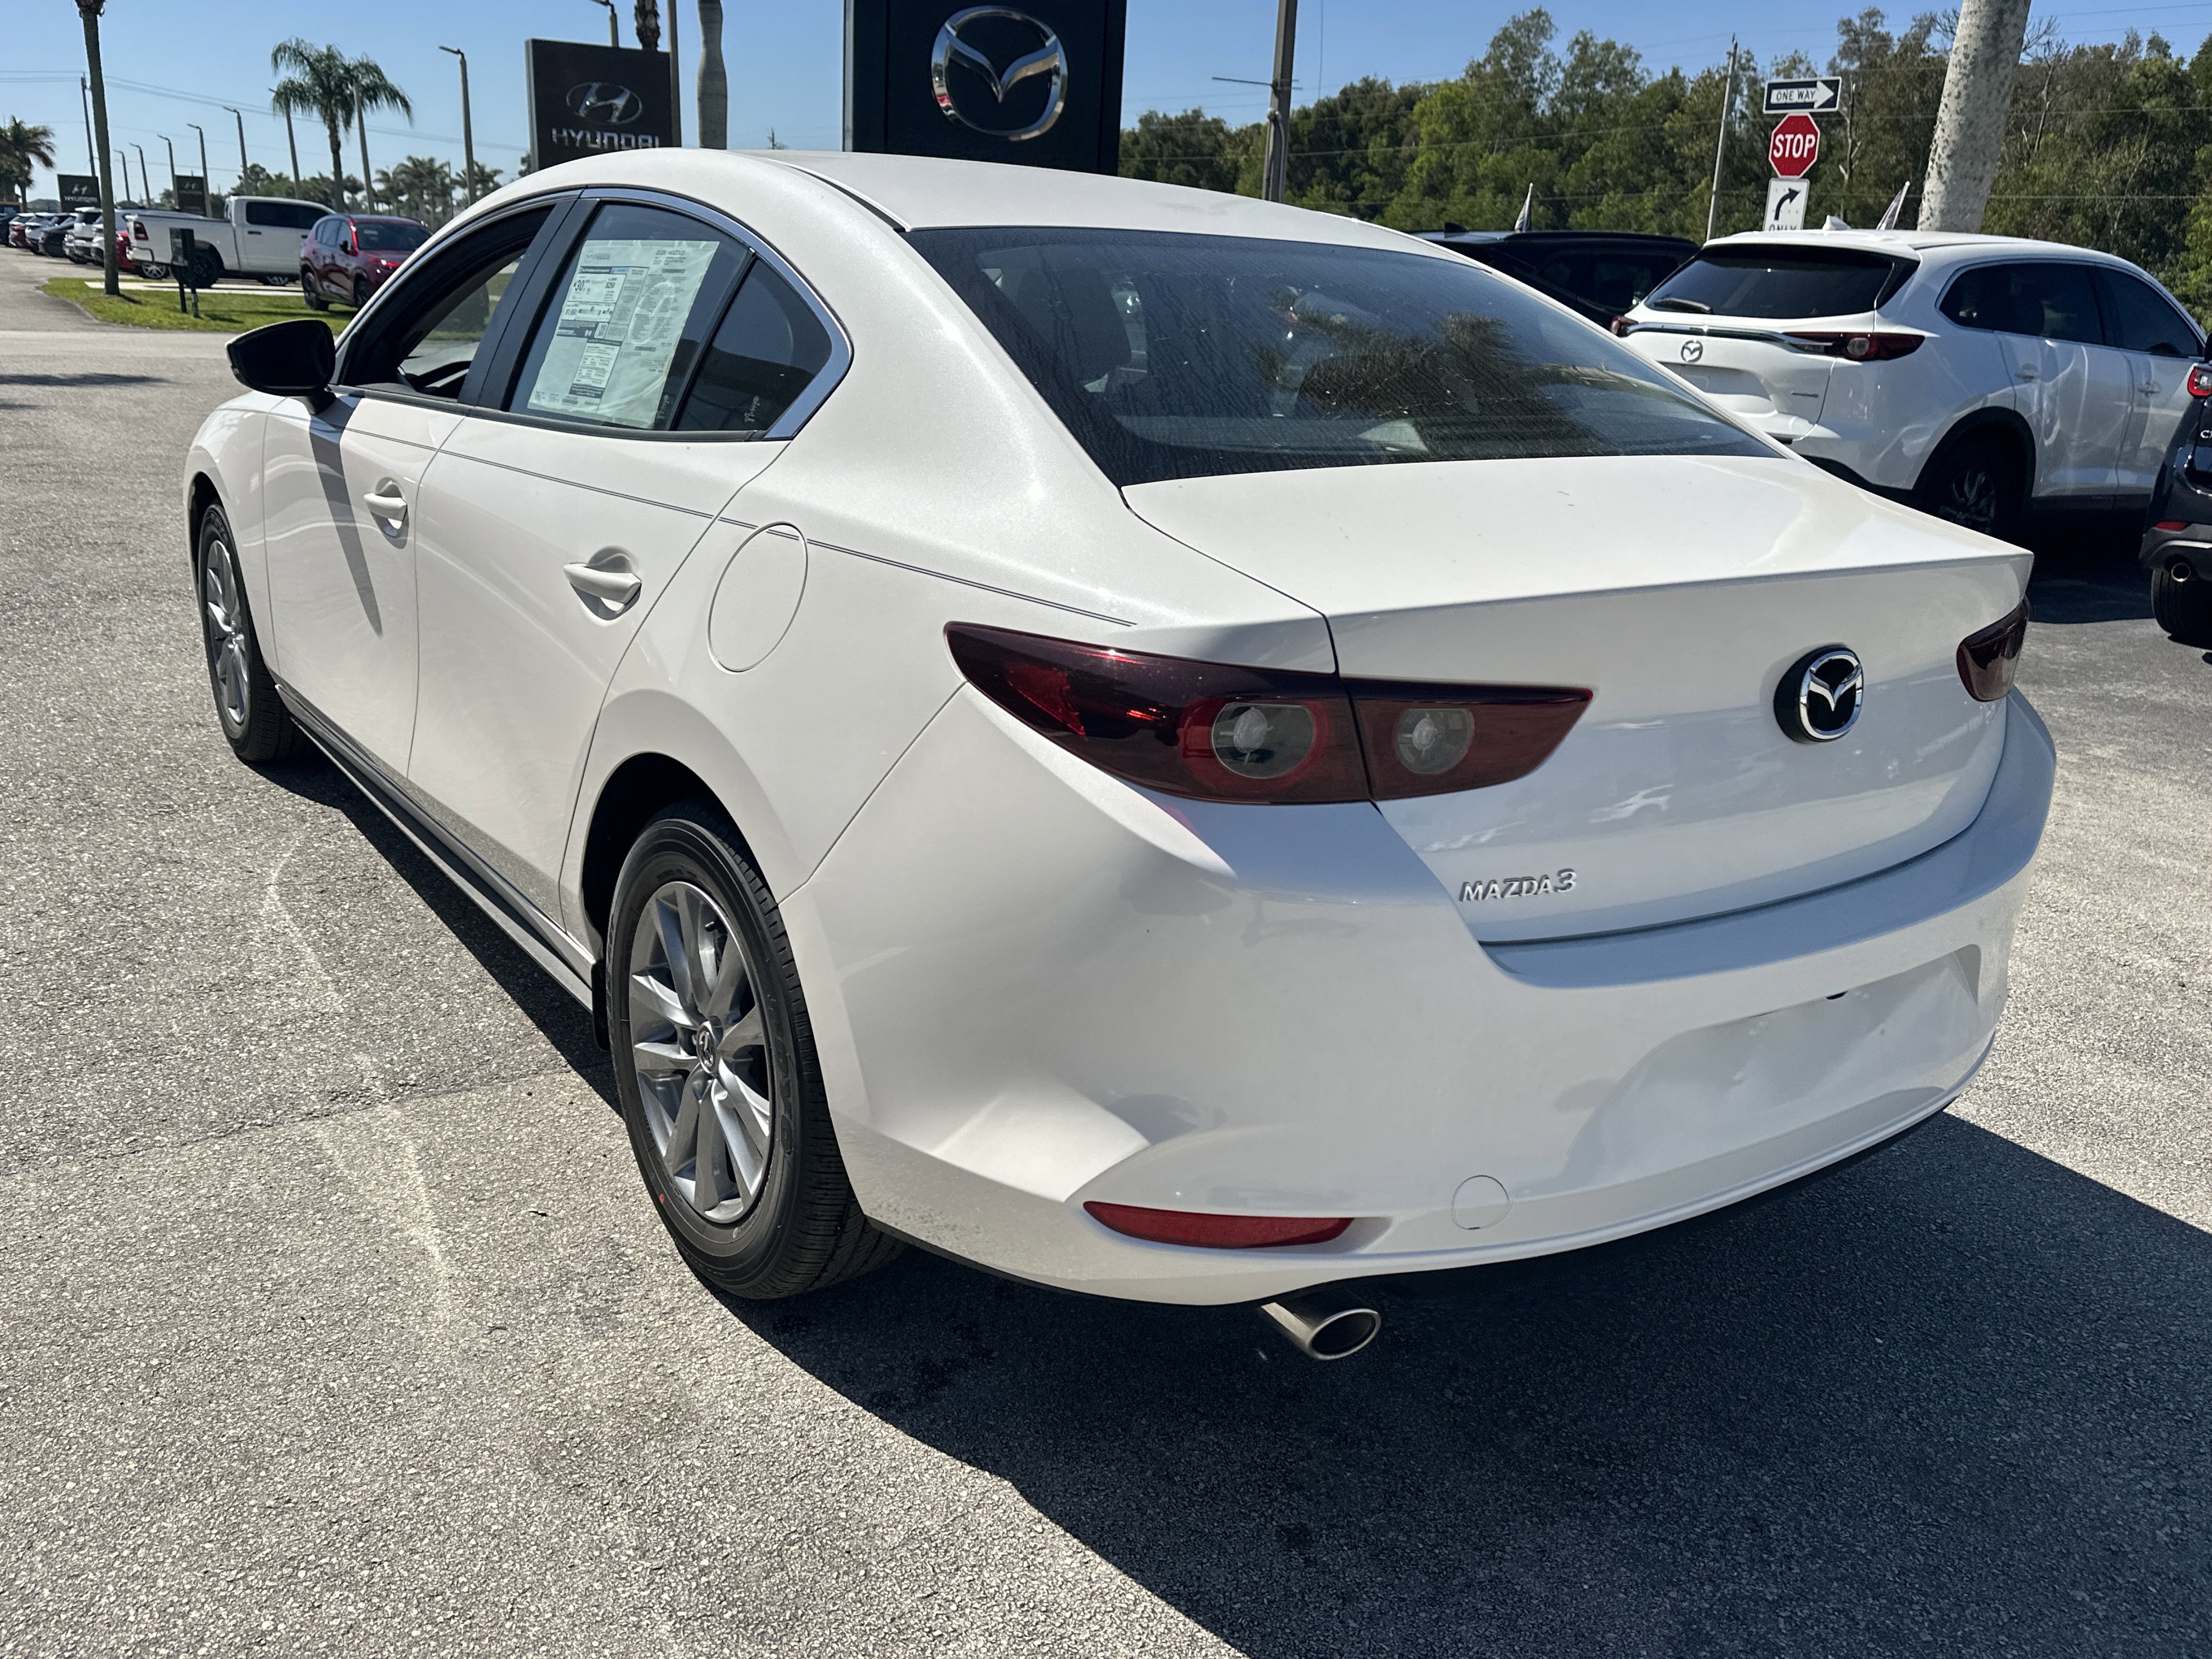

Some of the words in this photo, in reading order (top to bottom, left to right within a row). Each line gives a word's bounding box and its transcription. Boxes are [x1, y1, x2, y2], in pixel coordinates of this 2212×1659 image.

[1776, 91, 1793, 101] ONE
[1798, 90, 1815, 101] WAY
[551, 127, 659, 149] HYUNDAI
[1773, 133, 1816, 159] STOP
